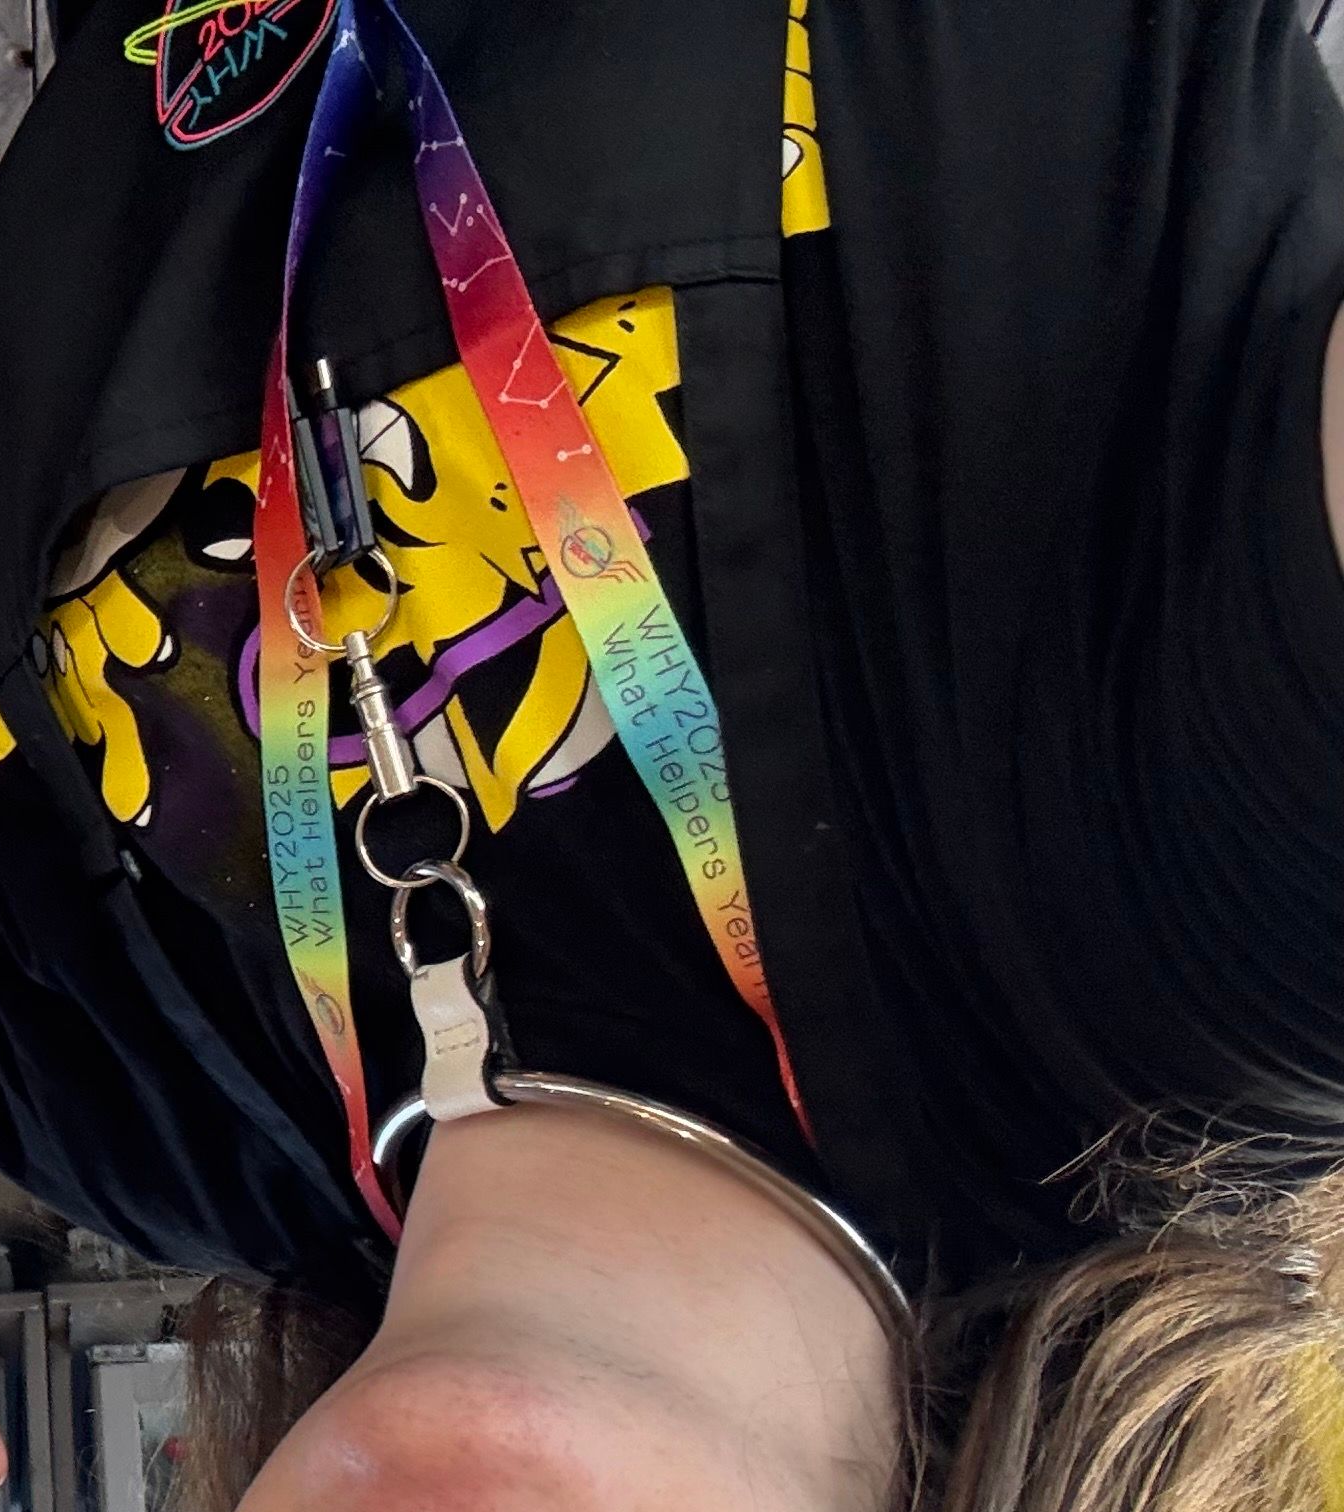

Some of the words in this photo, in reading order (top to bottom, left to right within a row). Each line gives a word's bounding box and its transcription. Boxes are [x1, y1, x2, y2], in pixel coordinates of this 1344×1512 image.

[187, 19, 288, 130] WHY
[296, 697, 322, 842] Helpers
[601, 621, 658, 728] What
[644, 733, 726, 881] Helpers
[265, 762, 311, 948] WHY2025
[303, 854, 334, 948] What
